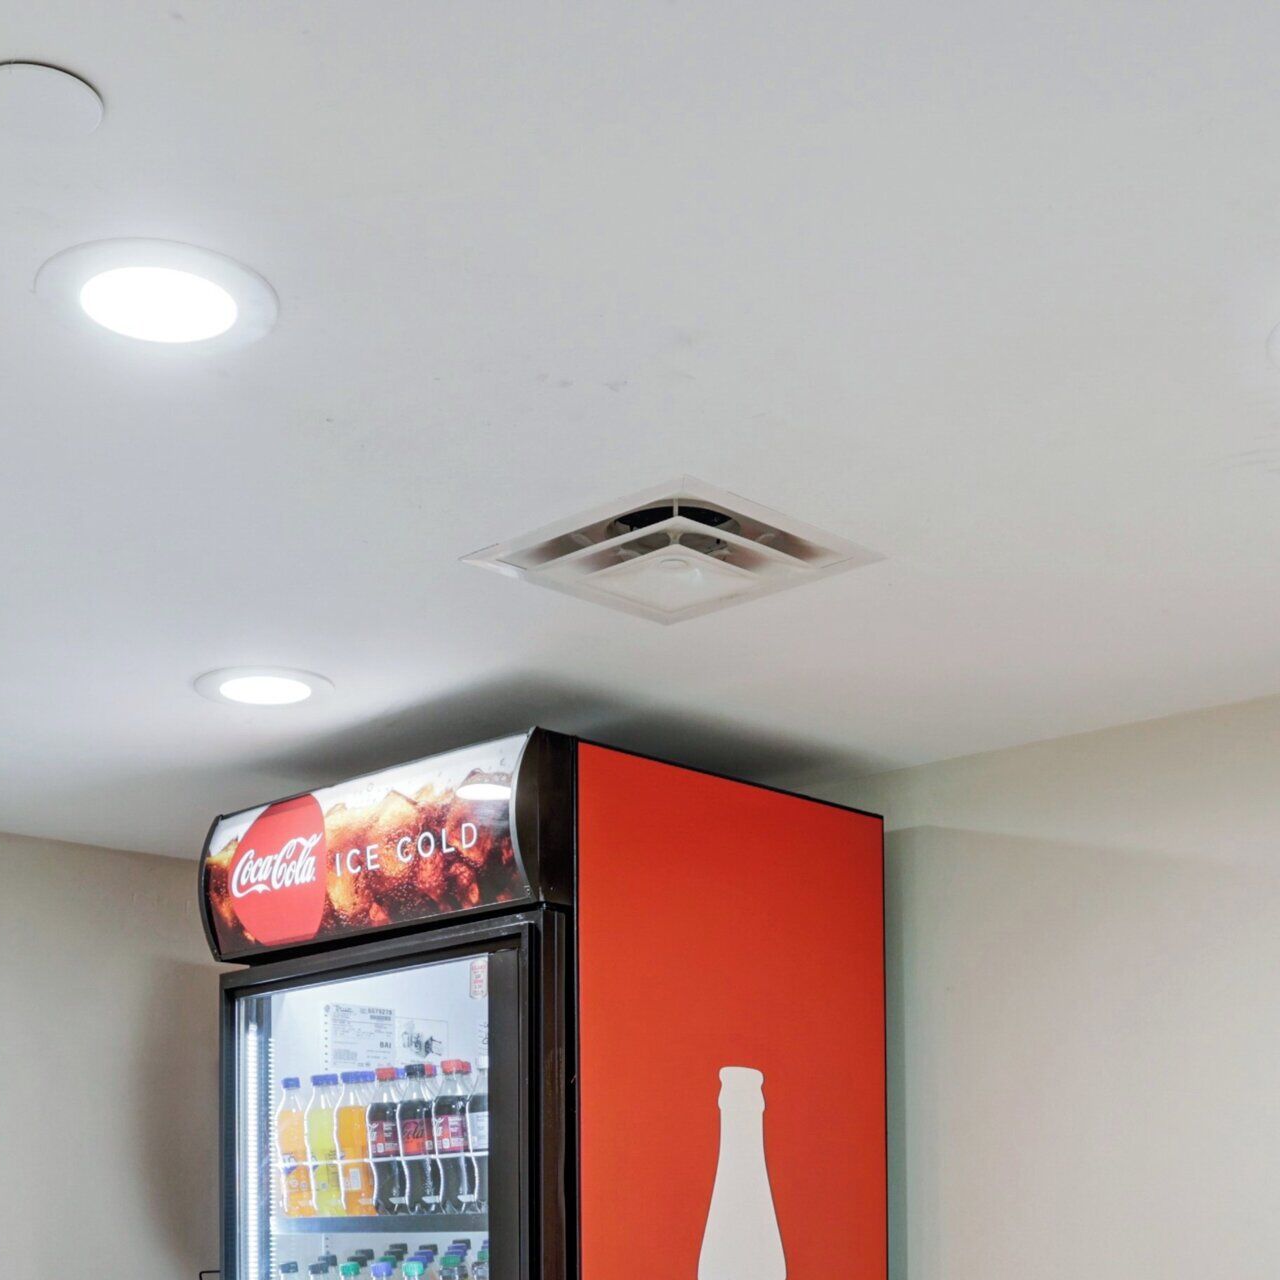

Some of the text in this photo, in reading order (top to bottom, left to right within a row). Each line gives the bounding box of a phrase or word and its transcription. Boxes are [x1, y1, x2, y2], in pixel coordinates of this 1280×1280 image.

[231, 832, 323, 898] Coca-Cola
[335, 822, 478, 877] ICE COLD
